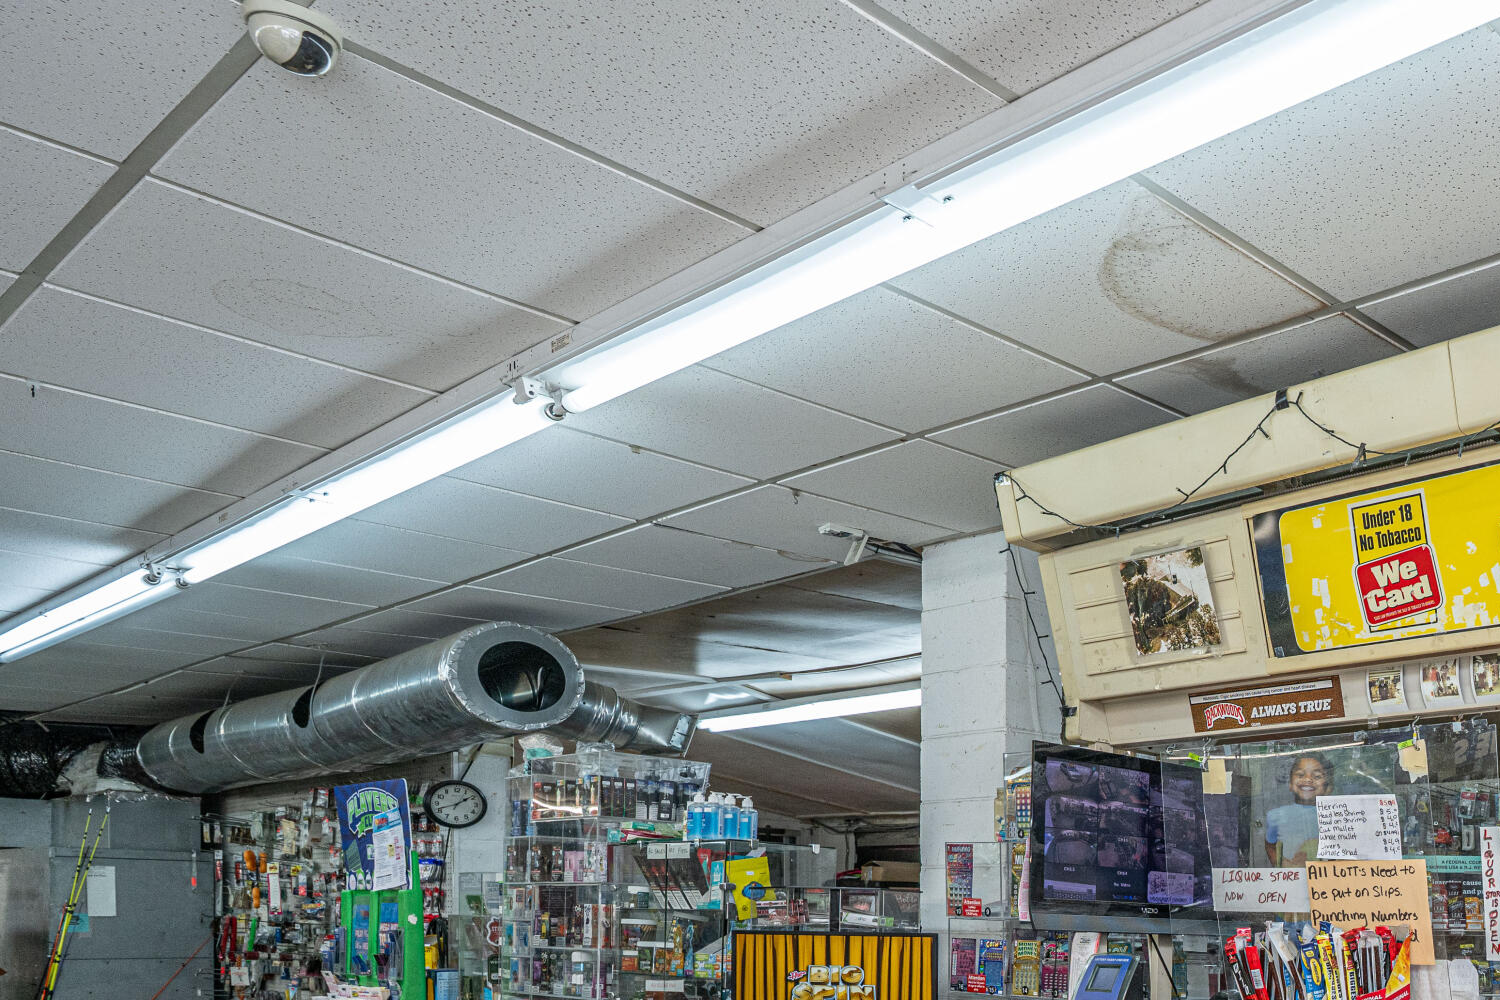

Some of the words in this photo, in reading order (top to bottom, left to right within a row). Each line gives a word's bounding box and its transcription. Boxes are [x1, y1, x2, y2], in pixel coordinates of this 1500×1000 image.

[1362, 509, 1396, 529] Under
[1399, 504, 1412, 522] 18
[1359, 534, 1374, 551] No
[1376, 527, 1421, 548] Tobacco
[1371, 559, 1418, 588] We
[1364, 574, 1433, 613] Card
[1204, 703, 1246, 729] BACKWOODS
[1250, 702, 1297, 719] ALWAYS
[1299, 699, 1333, 712] TRUE
[1221, 870, 1263, 884] LIQUOR
[1269, 871, 1300, 882] STORE
[1308, 865, 1328, 880] All
[1371, 866, 1398, 877] Need
[1398, 864, 1415, 876] to
[1224, 892, 1244, 904] NOW
[1258, 892, 1287, 904] OPEN
[1311, 887, 1329, 900] be
[1332, 887, 1352, 901] put
[1355, 886, 1370, 898] on
[1312, 911, 1367, 928] Punching
[1371, 910, 1418, 922] Numbers
[807, 965, 865, 985] BIG
